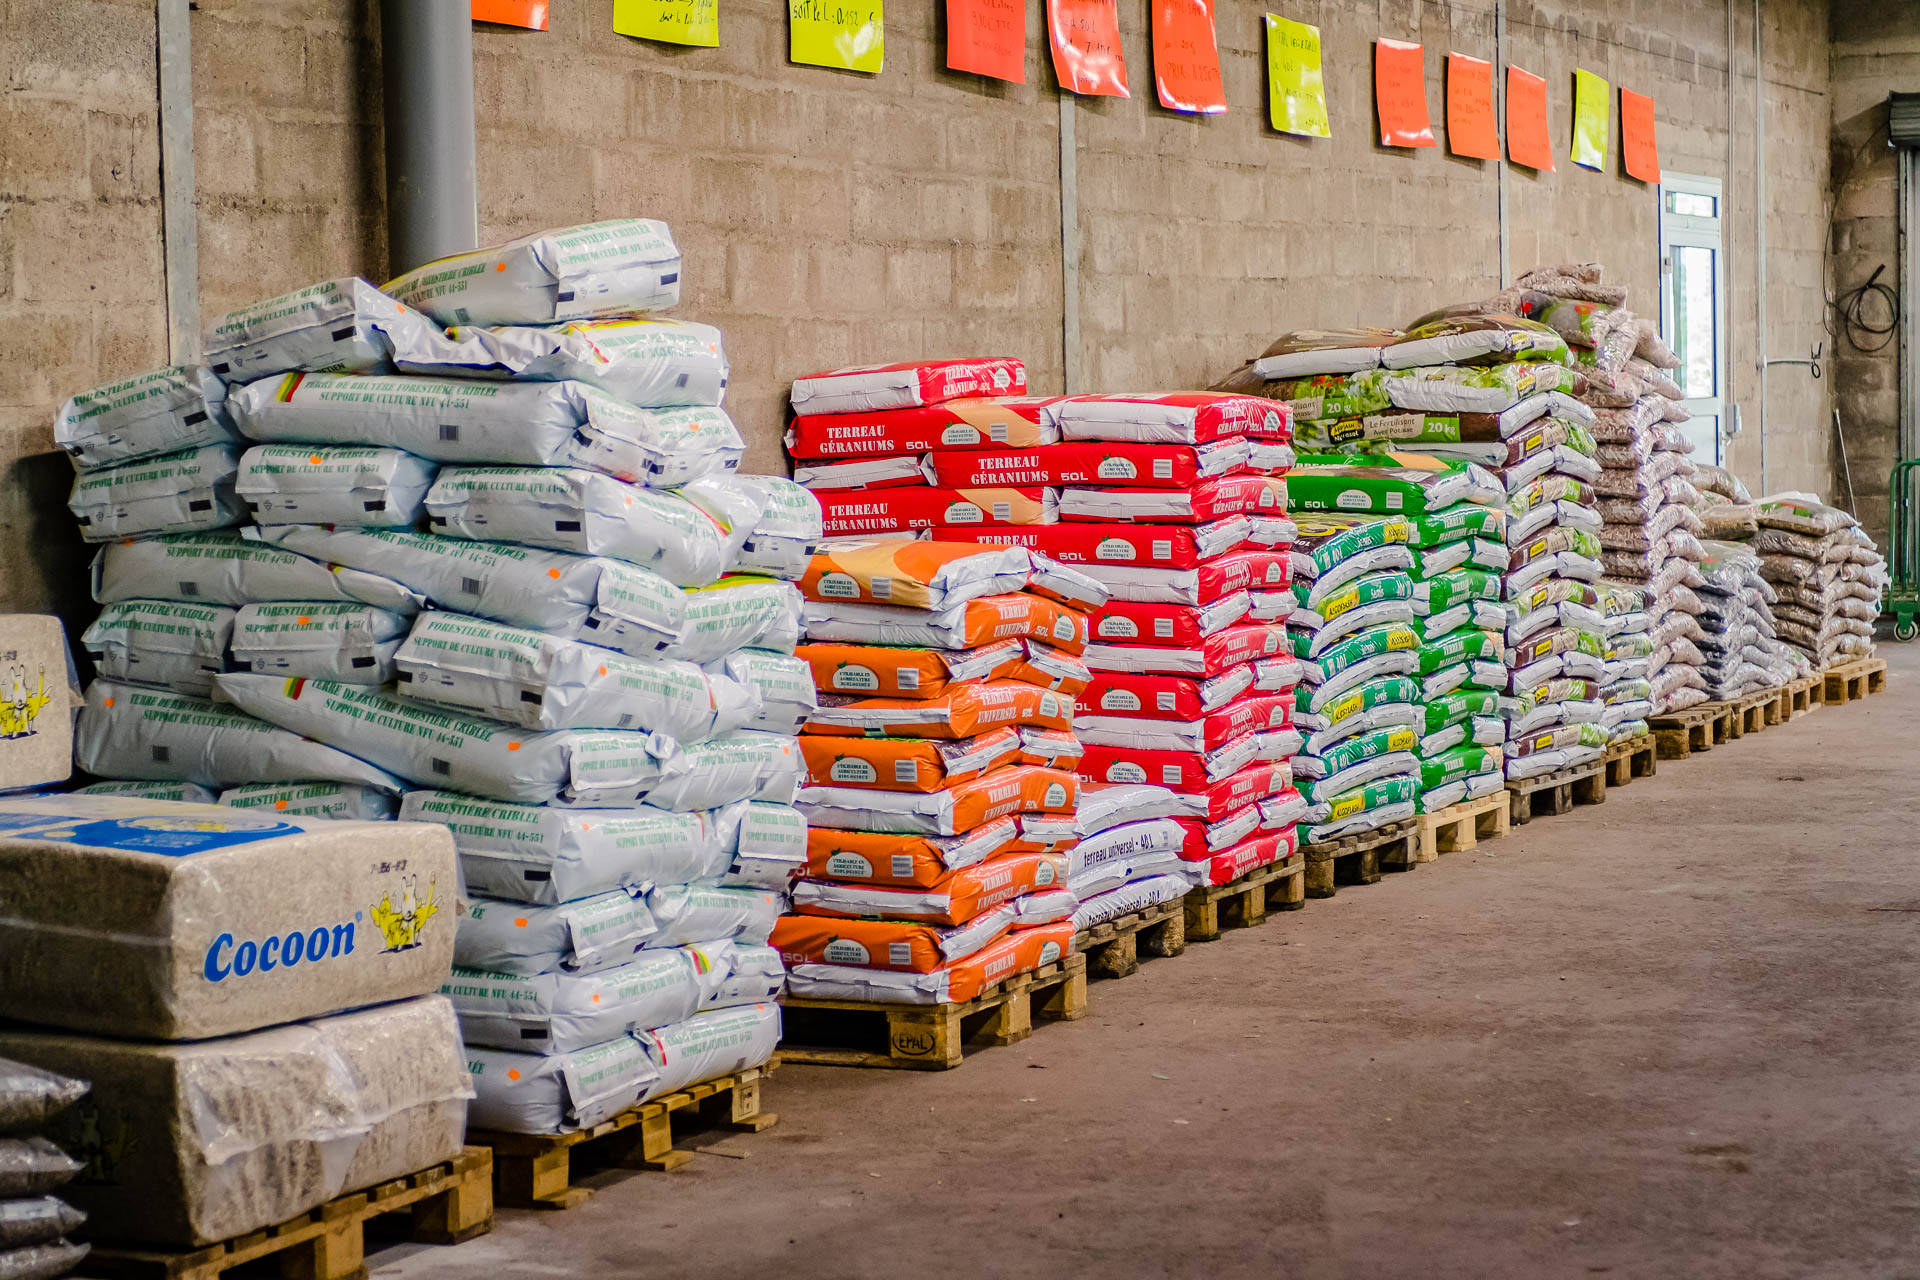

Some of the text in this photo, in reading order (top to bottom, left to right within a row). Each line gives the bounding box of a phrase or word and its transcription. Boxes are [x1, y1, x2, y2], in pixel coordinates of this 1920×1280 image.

[1327, 402, 1341, 414] 20
[826, 424, 886, 439] TERREAU
[1369, 420, 1378, 429] Le
[1427, 422, 1456, 436] 20 kg
[819, 439, 933, 454] GÉRANIUMS 50L
[978, 456, 1039, 470] TERREAU
[971, 470, 1088, 485] GÉRANIUMS 50L
[829, 503, 888, 517] TERREAU
[1304, 500, 1329, 509] 50L
[823, 517, 936, 531] GÉRANIUMS 50L
[977, 535, 1038, 547] TERREAU
[1059, 552, 1087, 561] 50L
[1084, 848, 1107, 867] terreau
[1108, 837, 1135, 858] universel
[204, 922, 355, 983] Cocoon
